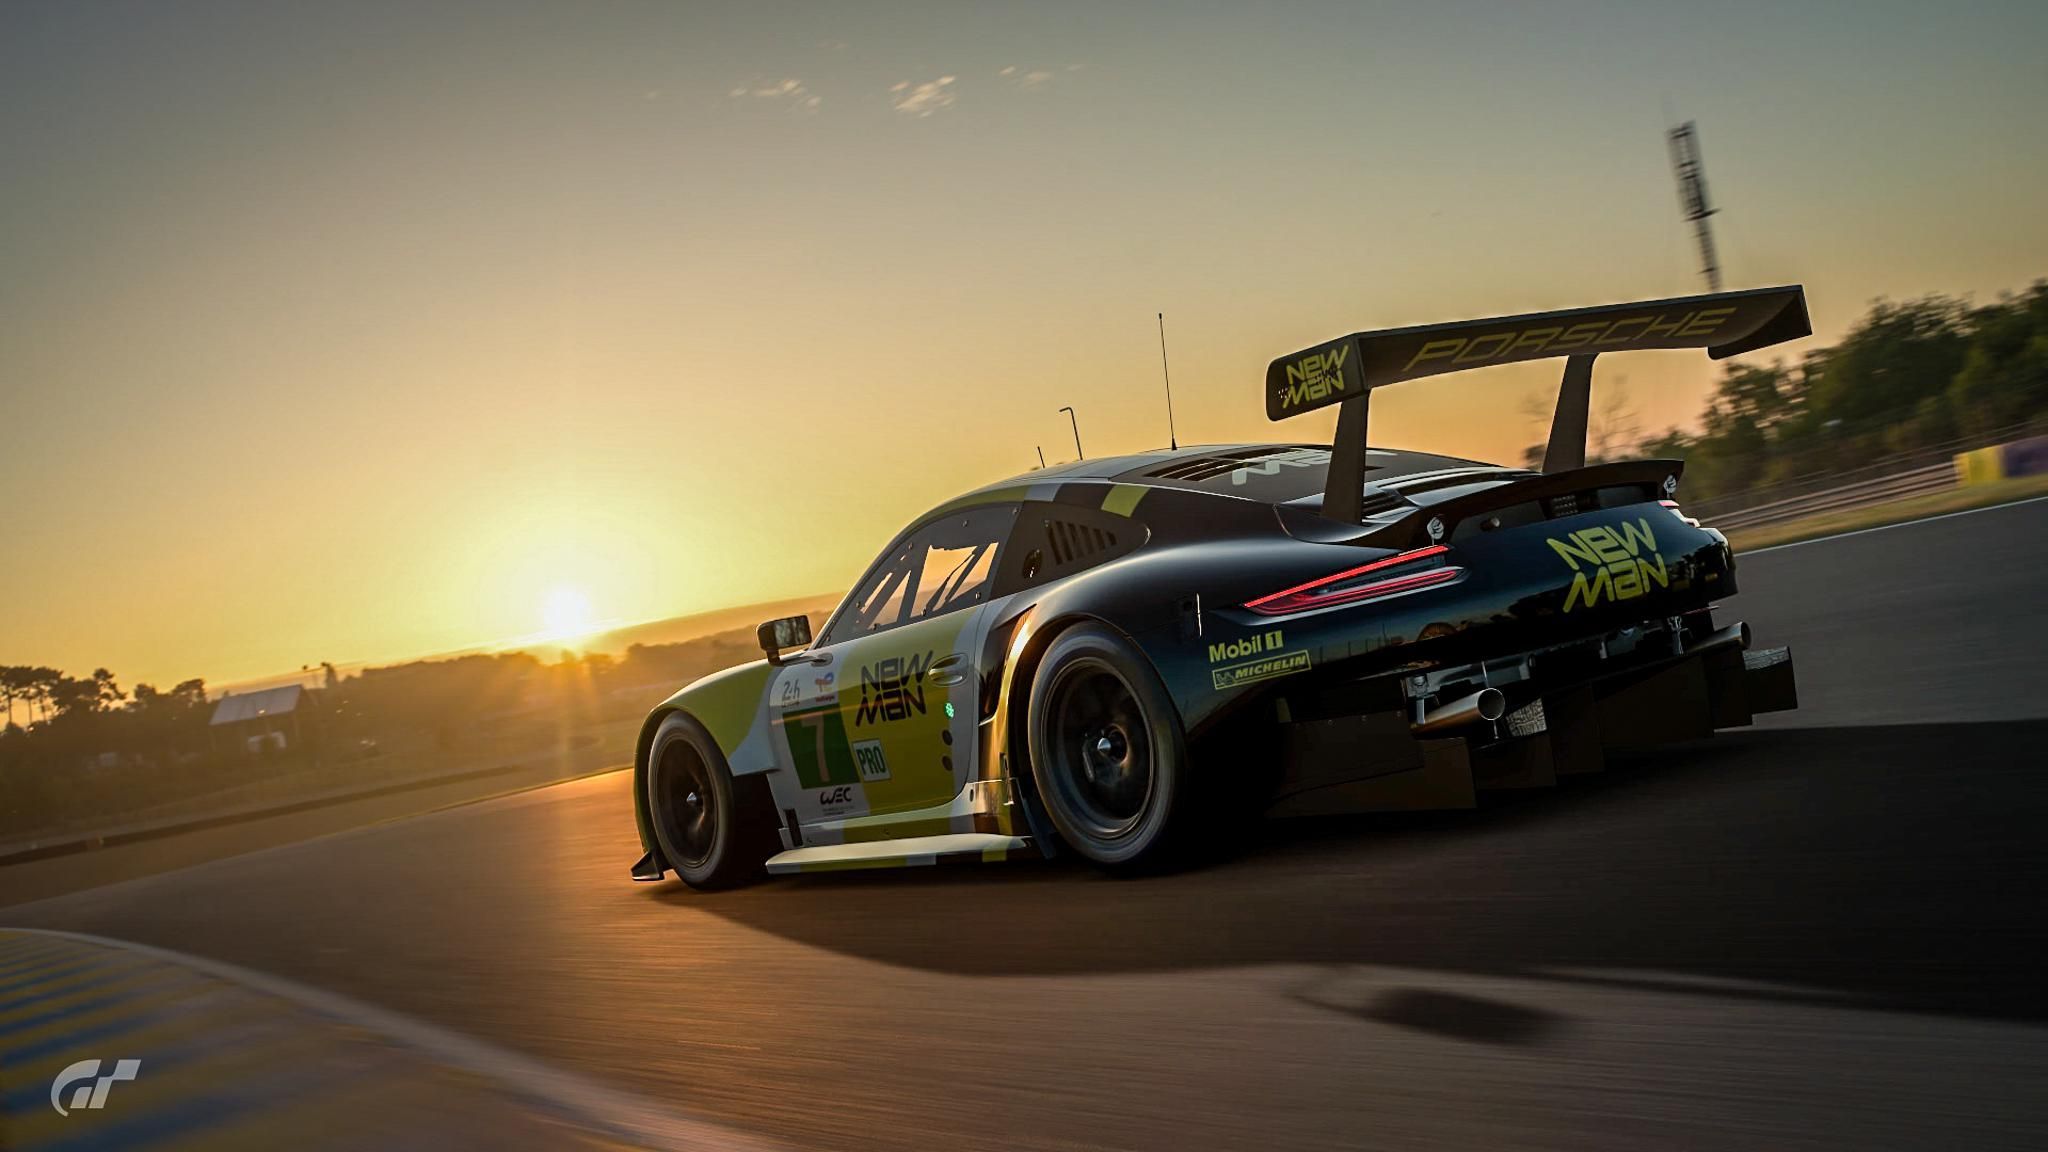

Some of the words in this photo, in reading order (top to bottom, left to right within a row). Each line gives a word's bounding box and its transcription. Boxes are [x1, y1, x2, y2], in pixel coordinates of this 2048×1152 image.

[1402, 307, 1736, 372] PORSCHE
[1286, 344, 1349, 385] NEW
[1546, 517, 1657, 570] NEW
[1562, 553, 1669, 613] MAN
[1209, 634, 1262, 663] Mobil
[1267, 631, 1282, 649] 1
[1235, 655, 1306, 679] MICHELIN
[861, 650, 933, 694] NEW
[856, 687, 927, 727] MAN
[801, 713, 830, 783] 7
[856, 745, 886, 775] PRO
[820, 786, 852, 805] WEC
